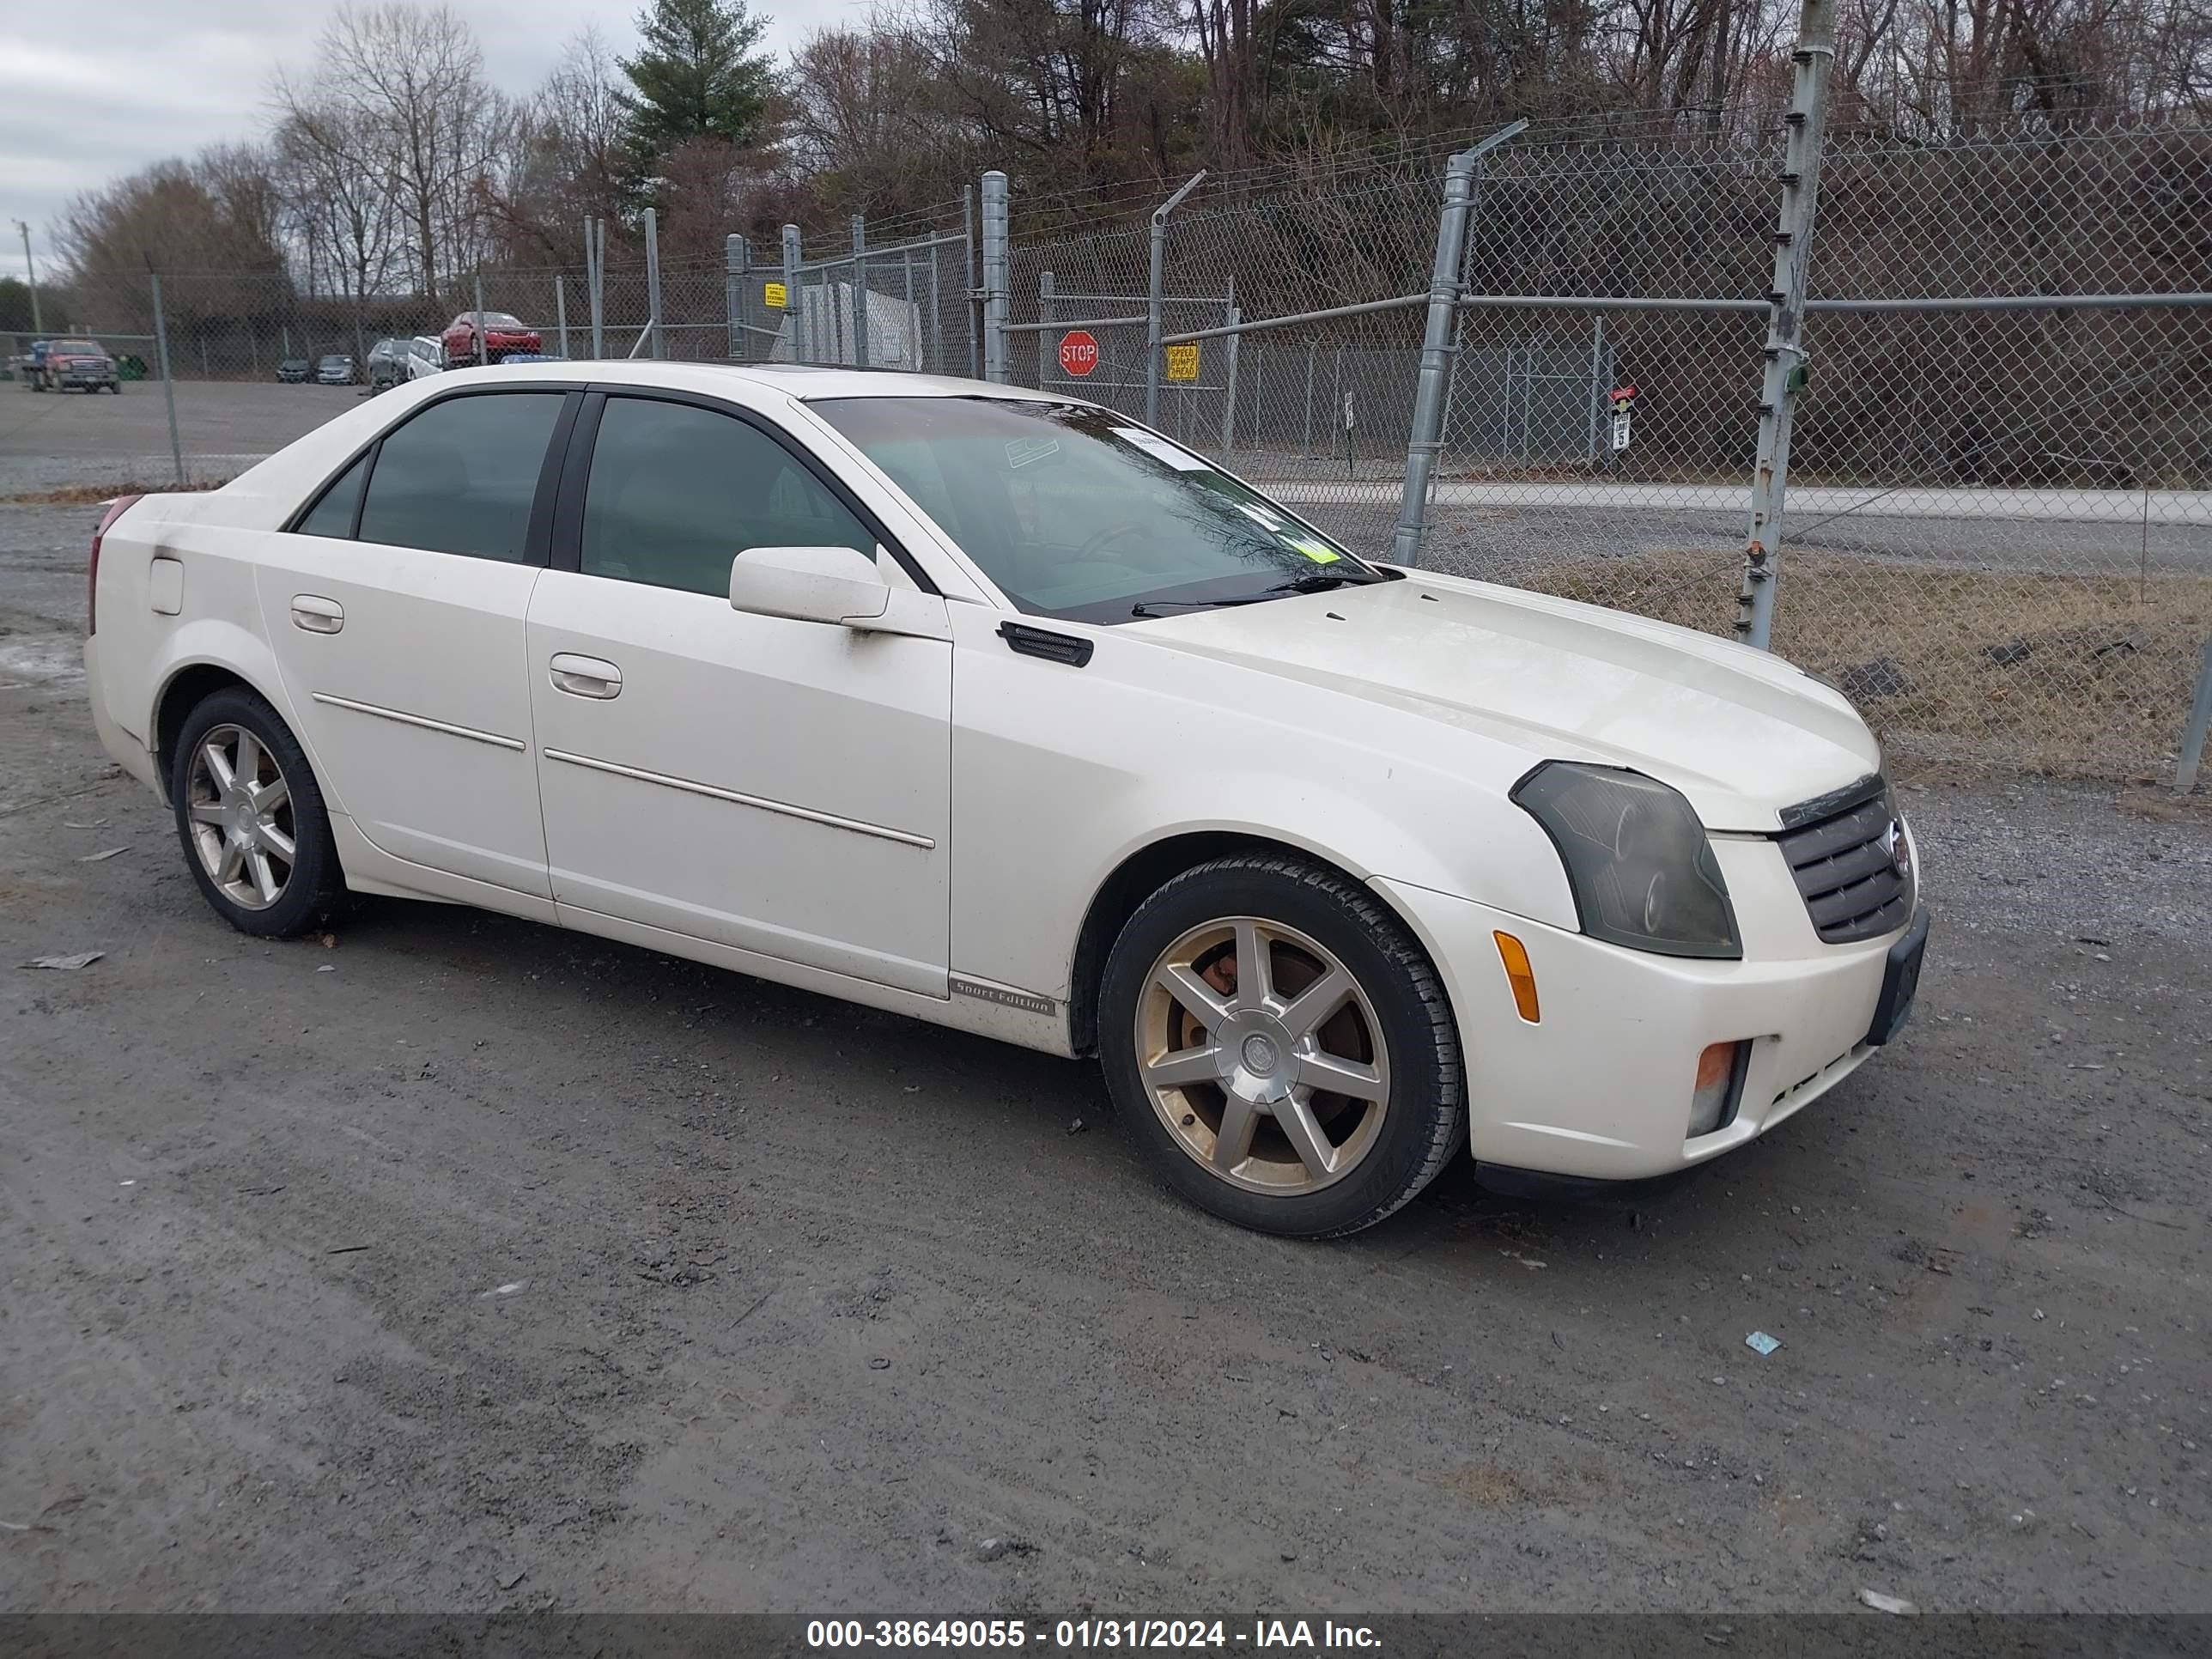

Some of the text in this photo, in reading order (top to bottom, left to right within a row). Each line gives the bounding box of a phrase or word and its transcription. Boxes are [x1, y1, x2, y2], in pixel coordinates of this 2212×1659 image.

[1062, 345, 1095, 362] STOP
[1171, 348, 1194, 357] SPEED
[1171, 357, 1195, 367] BUMPS
[1170, 367, 1194, 376] AHEAD
[1619, 432, 1625, 446] 5
[957, 981, 1048, 1012] Sport Edition
